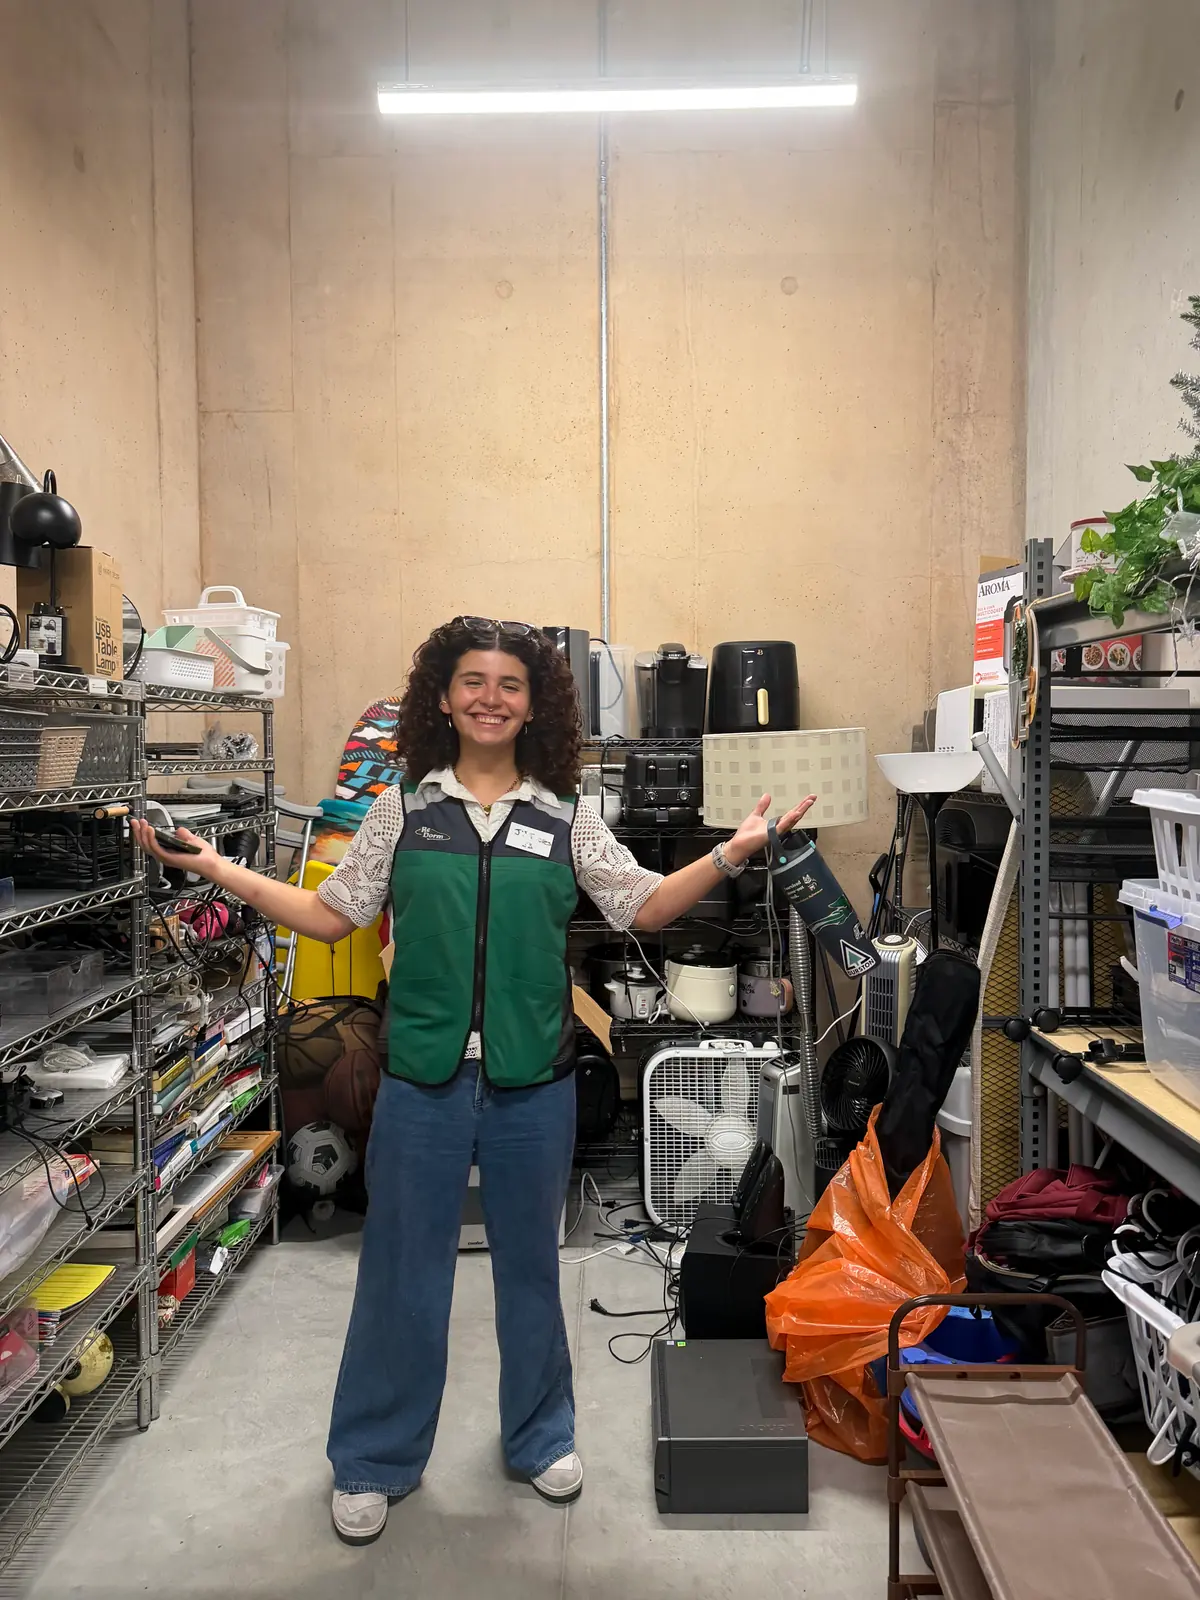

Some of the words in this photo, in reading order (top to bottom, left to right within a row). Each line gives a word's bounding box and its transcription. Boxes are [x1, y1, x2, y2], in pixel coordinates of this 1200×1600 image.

[978, 580, 1010, 598] AROMA
[95, 621, 112, 639] USB
[95, 636, 118, 657] Table
[95, 653, 116, 675] Lamp
[422, 832, 444, 840] Dorm
